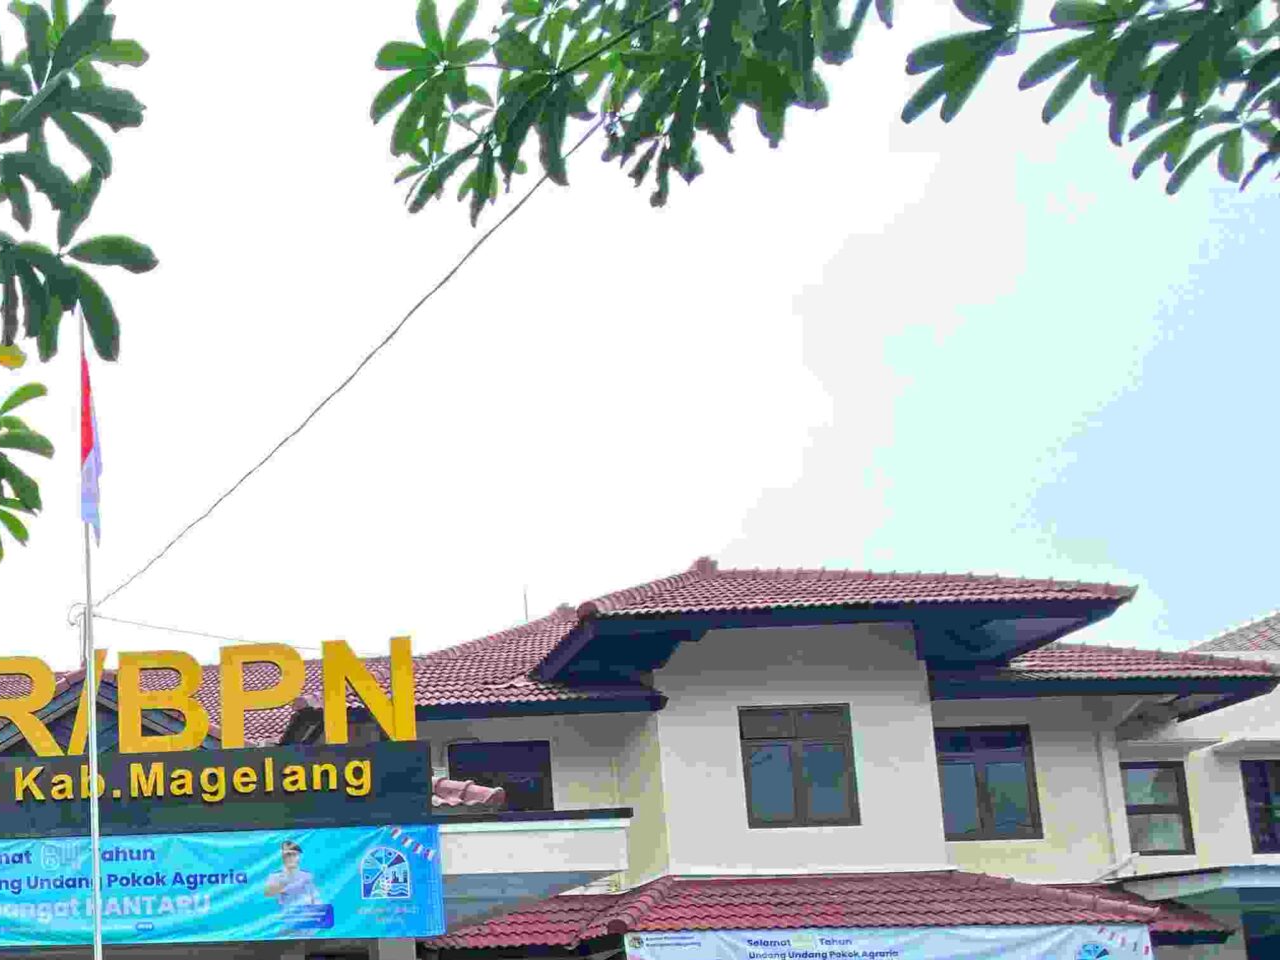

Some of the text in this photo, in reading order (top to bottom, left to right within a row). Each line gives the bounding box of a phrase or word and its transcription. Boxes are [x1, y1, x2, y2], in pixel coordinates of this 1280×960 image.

[107, 871, 166, 888] Pokok
[172, 869, 248, 890] Agraria
[746, 938, 791, 947] Selamat
[819, 937, 852, 946] Tahun
[748, 949, 899, 960] Undang Undang Pokok Agraria
